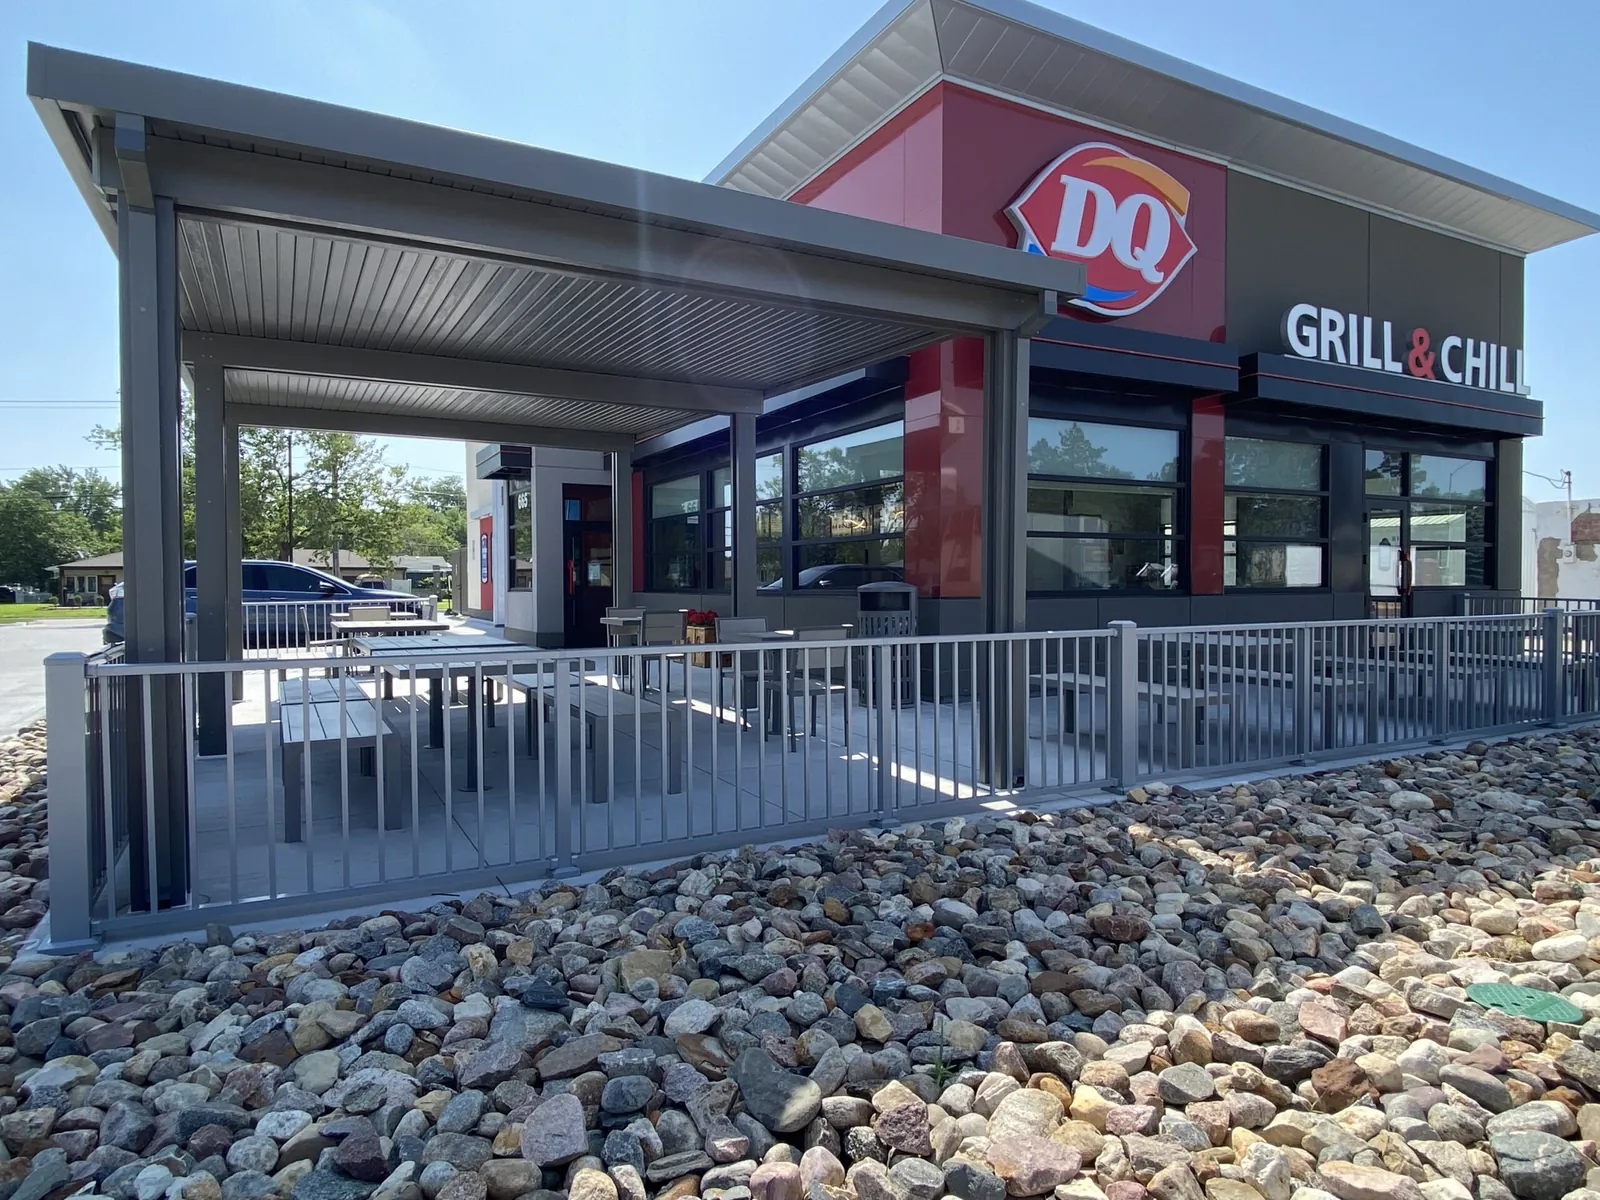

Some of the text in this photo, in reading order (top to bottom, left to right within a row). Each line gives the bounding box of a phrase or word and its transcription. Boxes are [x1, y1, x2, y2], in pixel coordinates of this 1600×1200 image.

[1051, 174, 1171, 284] DQ
[1285, 303, 1531, 395] GRILL & CHILL
